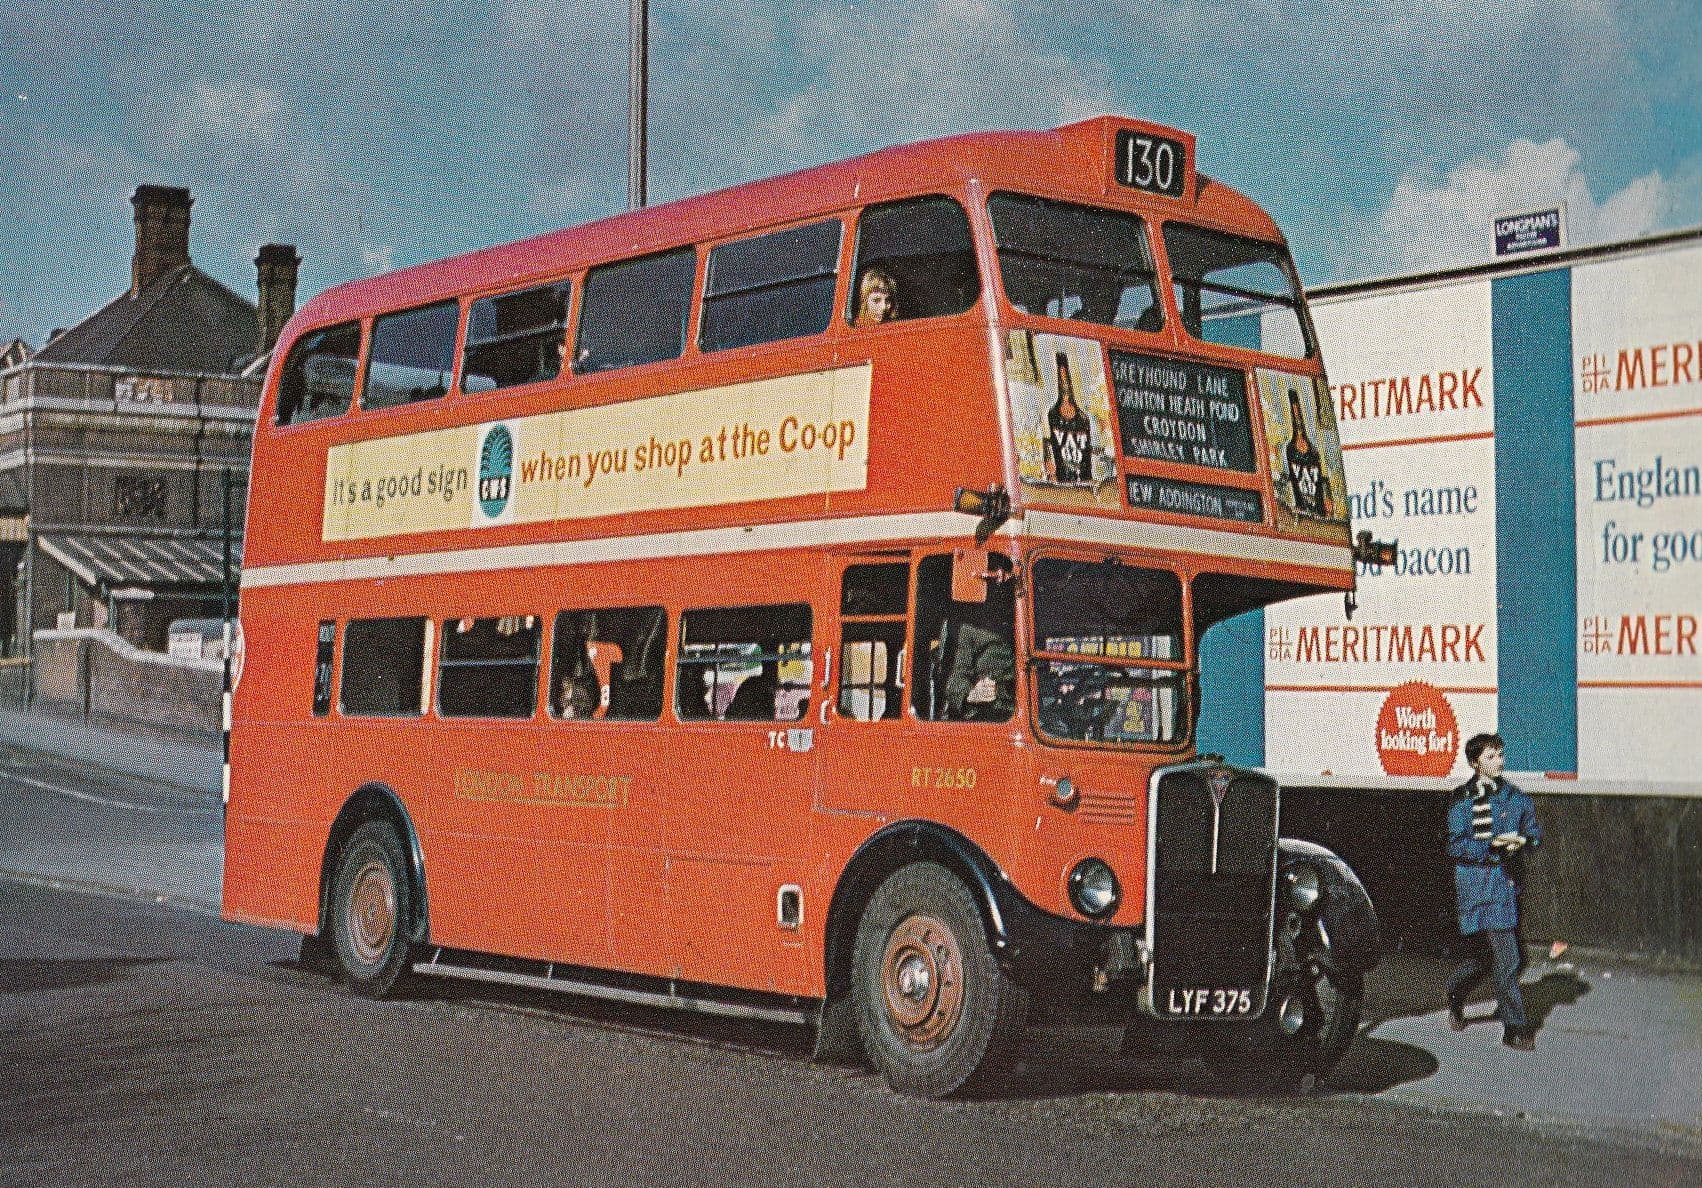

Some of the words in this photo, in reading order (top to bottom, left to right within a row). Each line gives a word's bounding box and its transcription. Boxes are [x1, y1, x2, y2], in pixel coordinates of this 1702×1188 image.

[1126, 137, 1174, 190] 130
[1197, 374, 1229, 398] LANE
[1169, 394, 1206, 419] HEATH
[1210, 400, 1240, 422] POND
[1052, 428, 1088, 450] VAT
[1144, 415, 1207, 442] CROYDON
[361, 481, 372, 501] a
[376, 466, 422, 508] good
[427, 464, 467, 502] sign
[520, 451, 581, 483] when
[585, 446, 628, 488] you
[634, 436, 692, 478] shop
[699, 425, 727, 463] at
[732, 422, 770, 457] the
[1130, 437, 1185, 460] SHIRLEY
[1193, 446, 1229, 469] PARK
[1291, 463, 1319, 483] VAT
[1158, 486, 1223, 517] ADDINGTON
[1403, 485, 1477, 516] name
[1602, 520, 1643, 563] for
[1296, 624, 1486, 662] MERITMARK
[1395, 706, 1437, 730] Worth
[1381, 728, 1427, 755] looking
[1428, 730, 1453, 753] for!
[911, 767, 933, 788] RT
[1169, 988, 1209, 1014] LYF
[1212, 988, 1251, 1014] 375
